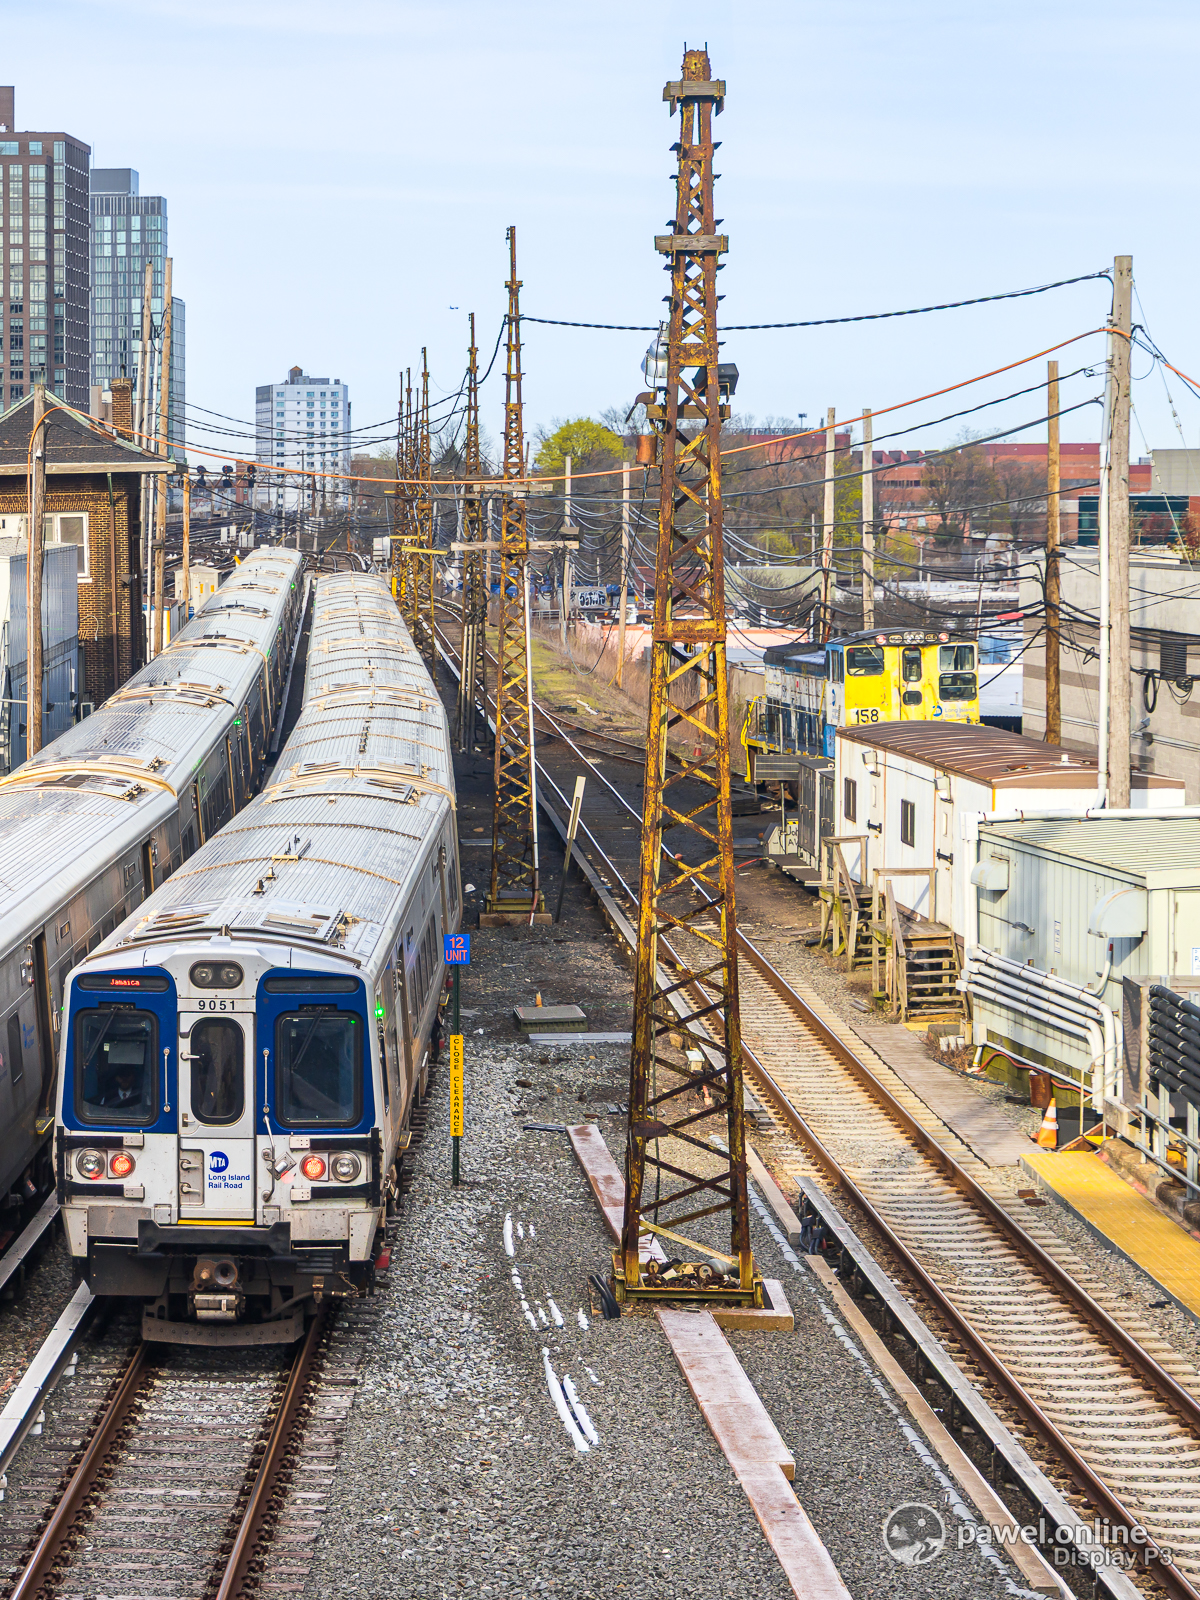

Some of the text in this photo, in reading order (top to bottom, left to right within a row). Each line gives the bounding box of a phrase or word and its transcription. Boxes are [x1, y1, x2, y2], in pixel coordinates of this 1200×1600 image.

[856, 708, 879, 723] 158
[449, 936, 465, 949] 12
[445, 949, 468, 962] UNIT
[110, 978, 141, 987] Jamaica
[198, 999, 235, 1011] 9051
[208, 1174, 227, 1182] Long
